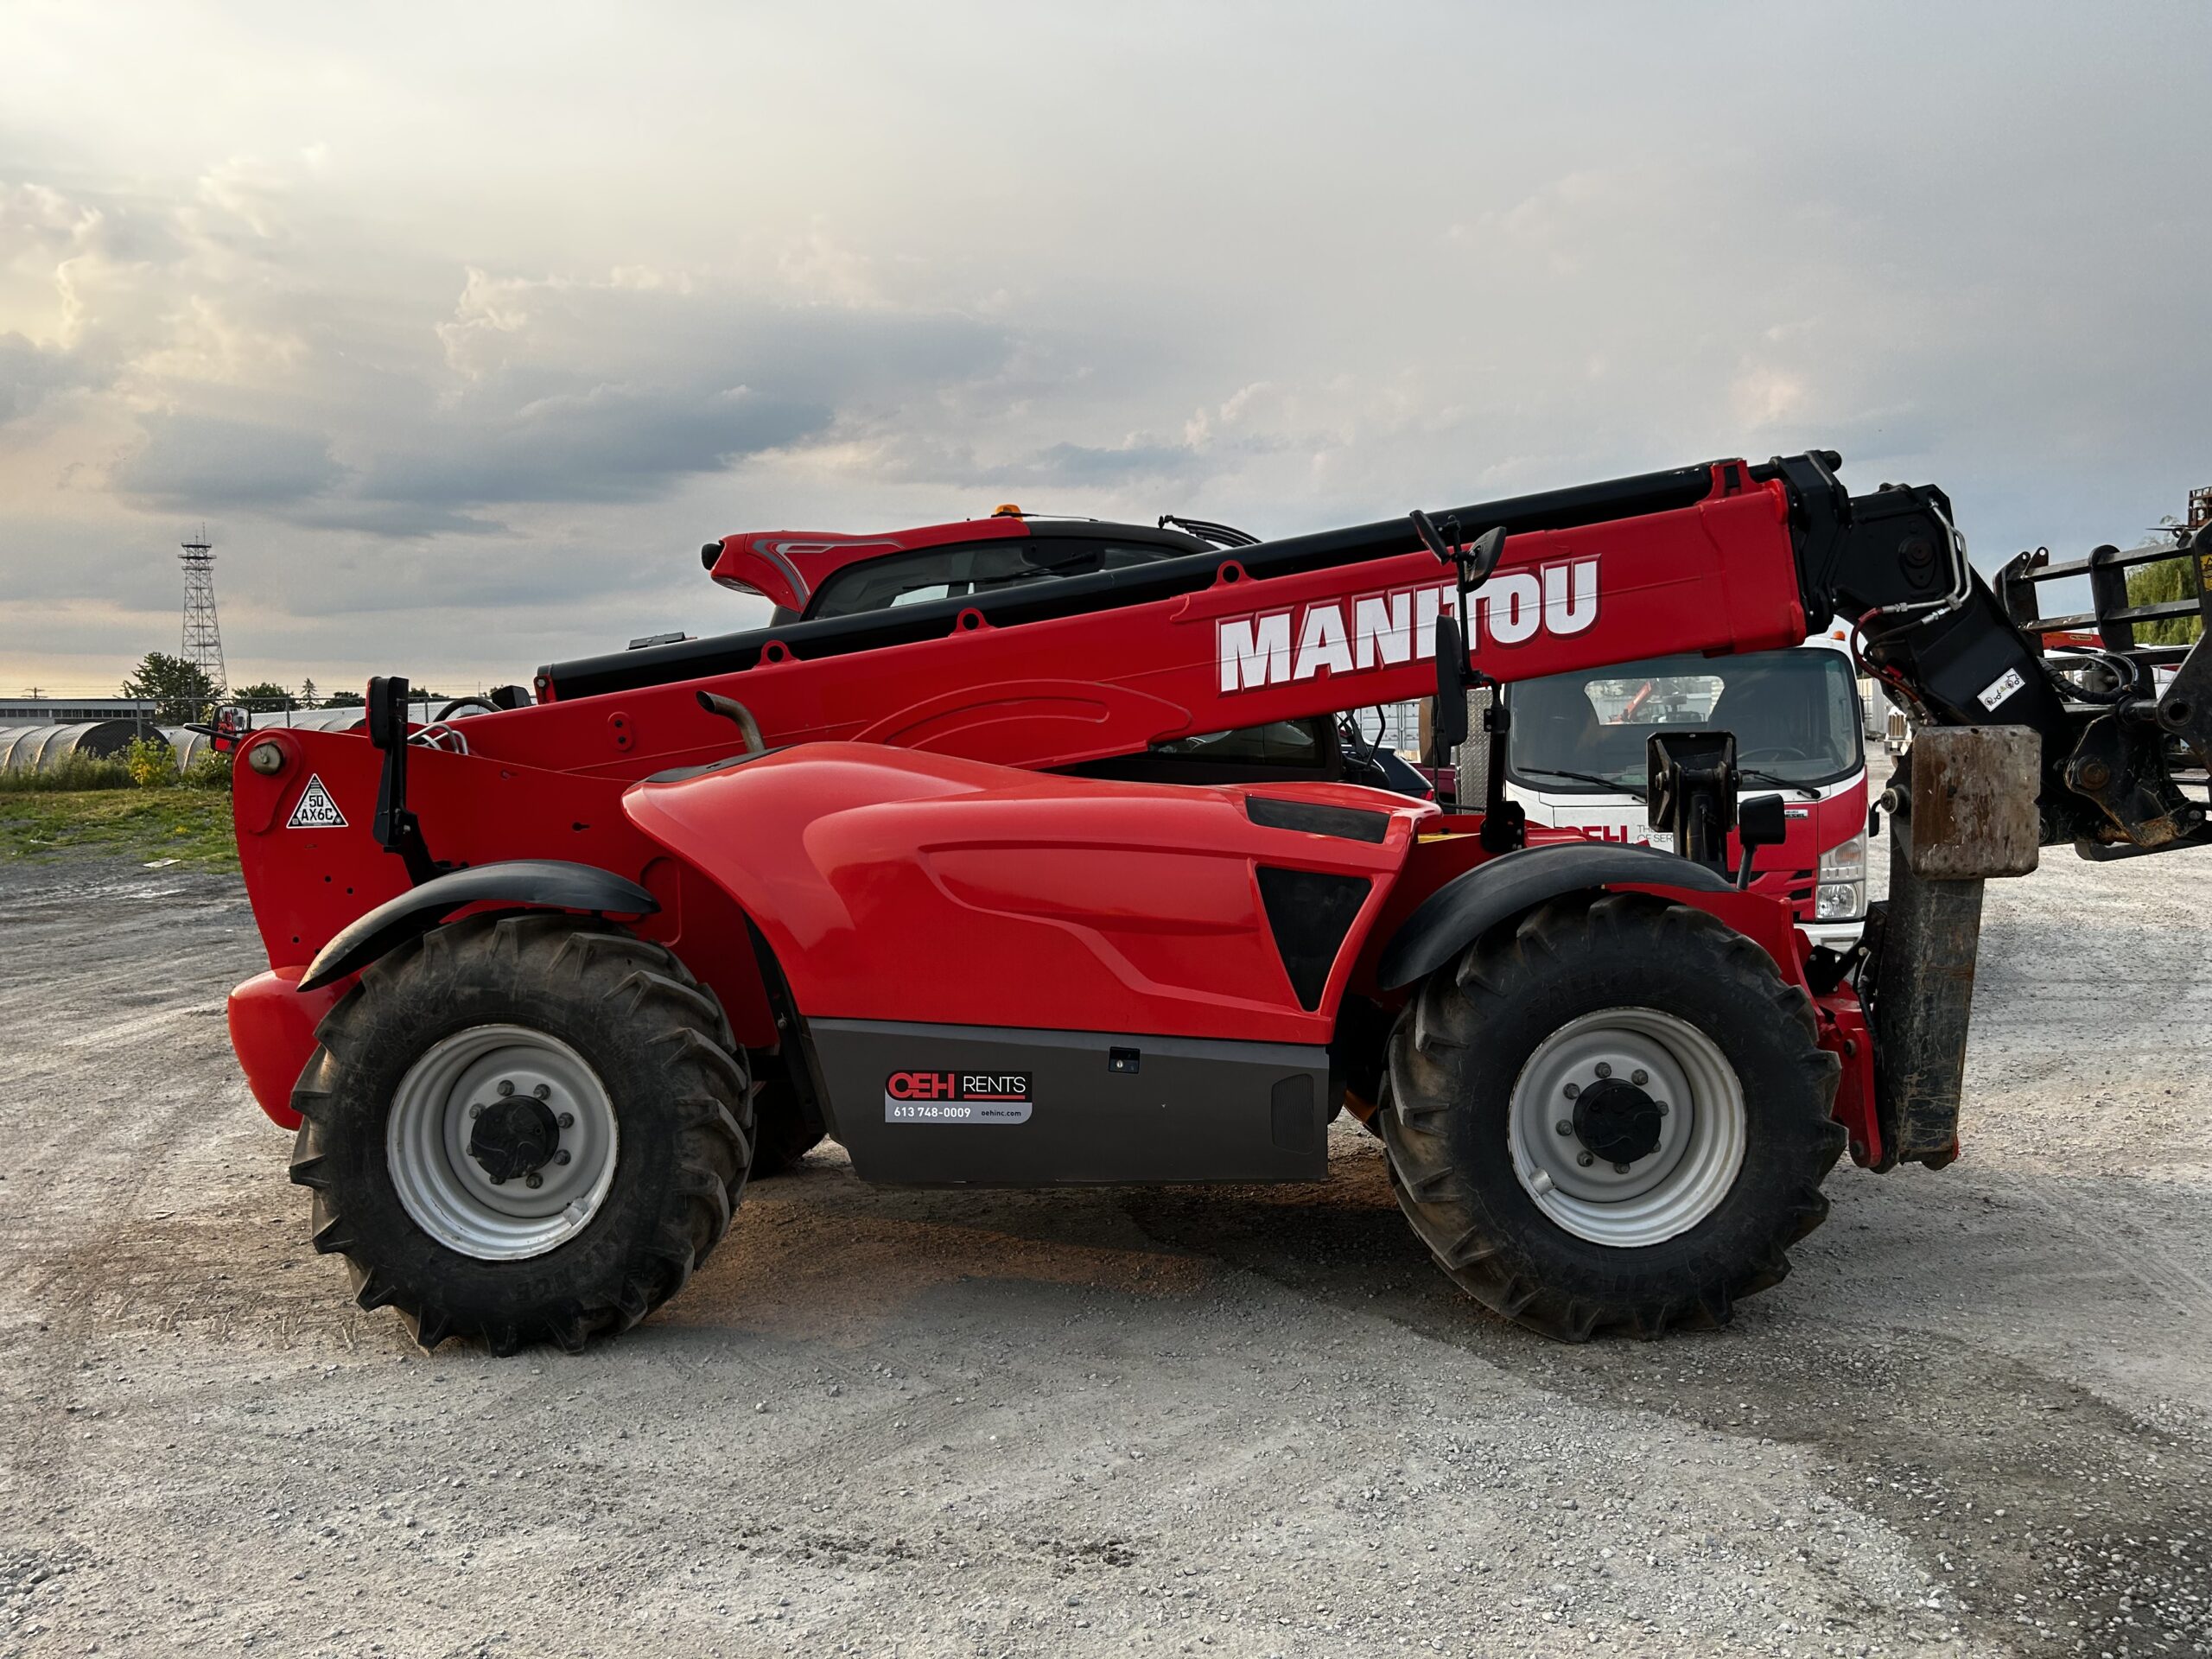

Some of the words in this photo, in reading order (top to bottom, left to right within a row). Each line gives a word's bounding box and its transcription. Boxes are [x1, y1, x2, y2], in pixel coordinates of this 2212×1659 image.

[1219, 558, 1599, 693] MANITOU
[301, 807, 334, 822] AX6C
[1653, 834, 1674, 843] SER
[888, 1072, 955, 1098] OEH
[963, 1076, 1027, 1093] RENTS
[893, 1106, 915, 1117] 613
[918, 1107, 971, 1118] 748-0009
